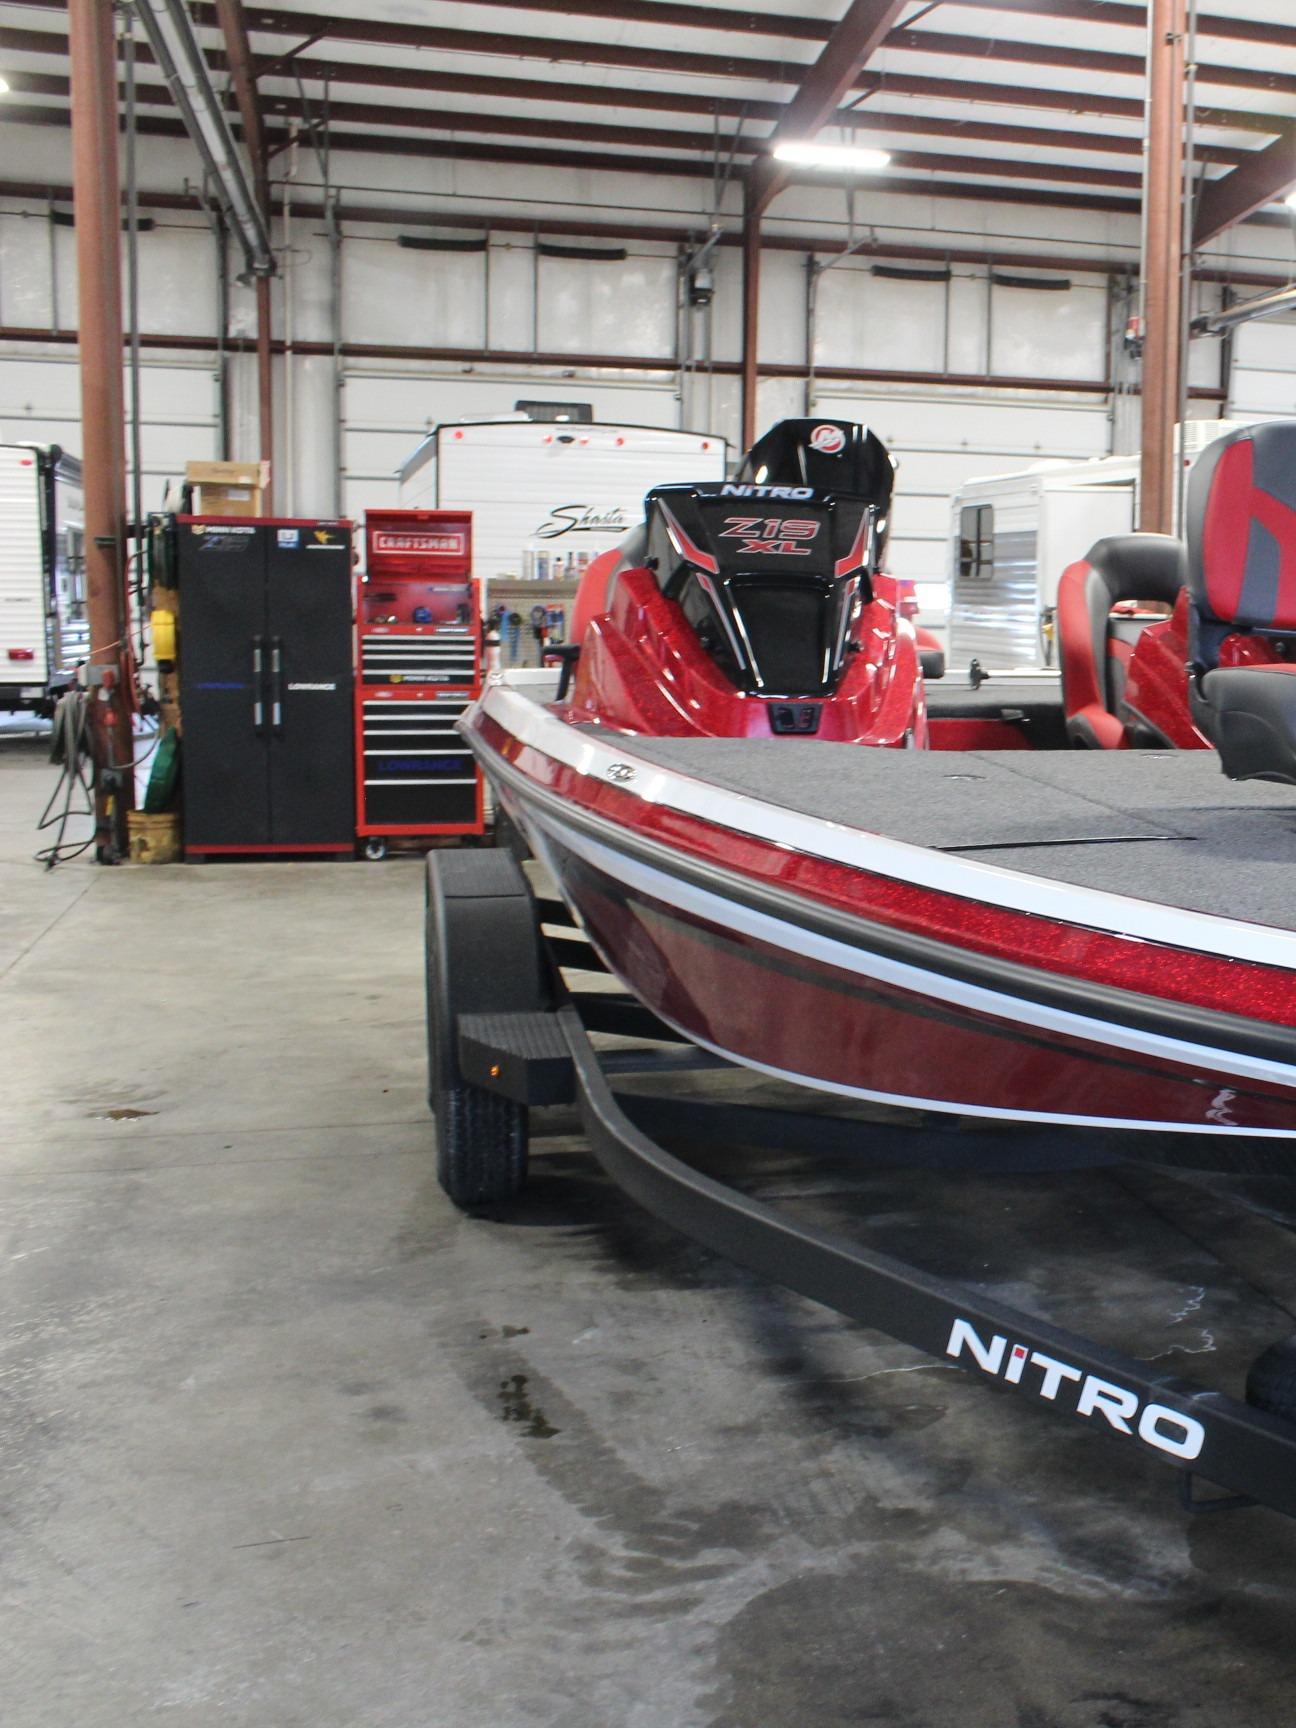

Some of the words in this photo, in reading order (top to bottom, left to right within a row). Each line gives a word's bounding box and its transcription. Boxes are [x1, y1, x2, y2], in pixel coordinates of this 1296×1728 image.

[720, 484, 815, 500] NITRO
[529, 504, 629, 539] Shasta
[718, 517, 821, 540] Z19
[379, 536, 458, 550] CRAFTSMAN
[736, 539, 811, 555] XL
[946, 1318, 1206, 1460] NITRO
